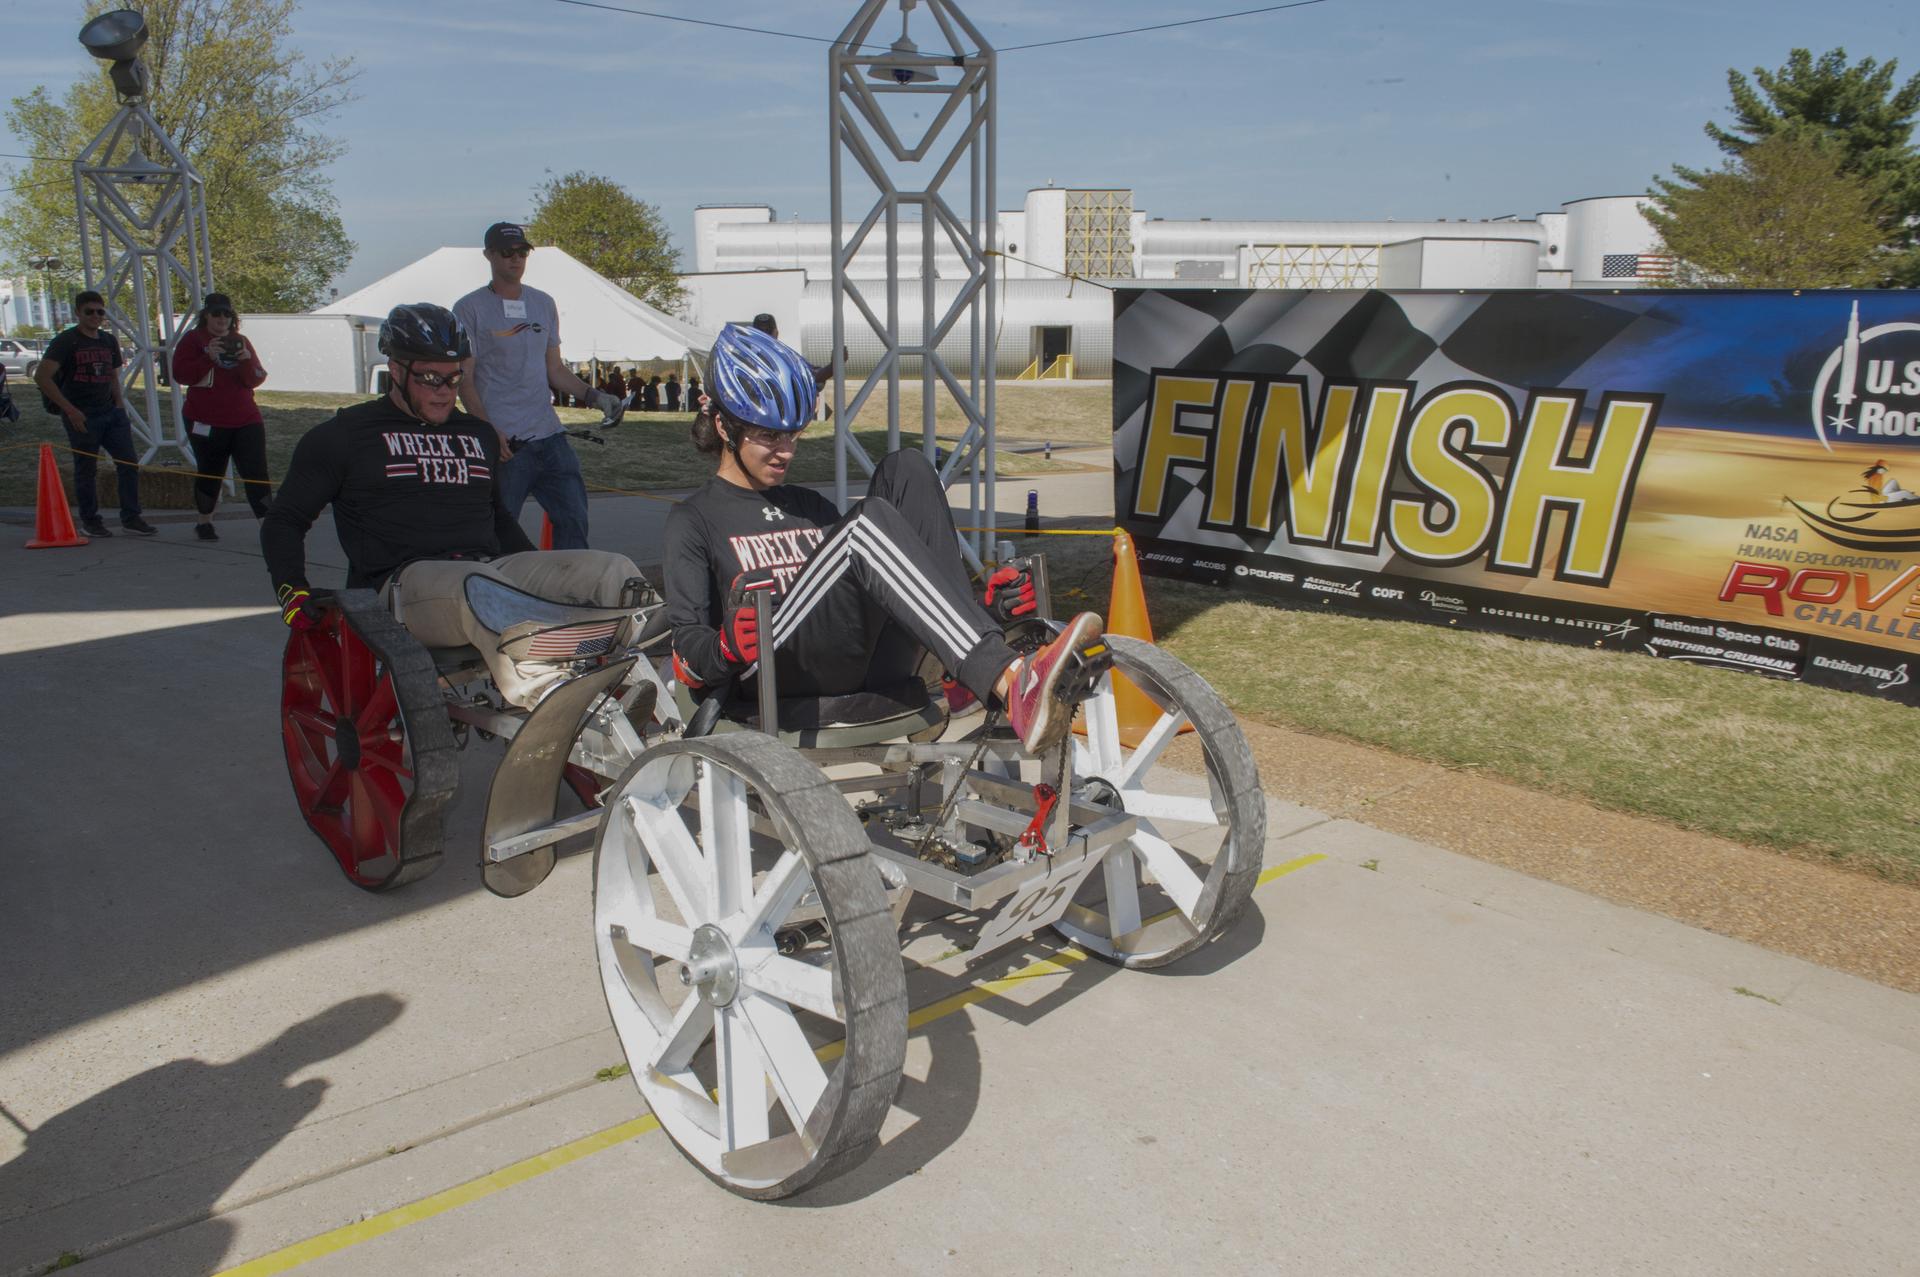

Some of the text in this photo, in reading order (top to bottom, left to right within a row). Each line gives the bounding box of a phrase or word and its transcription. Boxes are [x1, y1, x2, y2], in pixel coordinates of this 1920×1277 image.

[382, 432, 455, 457] WRECK'
[417, 457, 469, 485] TECH
[1130, 369, 1662, 586] FINISH
[1744, 523, 1799, 543] NASA
[1145, 553, 1184, 564] BOEING
[1192, 560, 1226, 571] JACOBS
[1737, 543, 1902, 571] HUMAN EXPLORATION
[1248, 569, 1295, 583] POLARIS
[1371, 587, 1404, 600] COPT
[1481, 606, 1612, 632] LOCKHEED MARTIN
[1653, 618, 1800, 651] National Space Club
[1650, 636, 1796, 671] NORTHROP GRUMMAN
[1813, 655, 1894, 681] Orbital ATK
[996, 869, 1081, 937] 95
